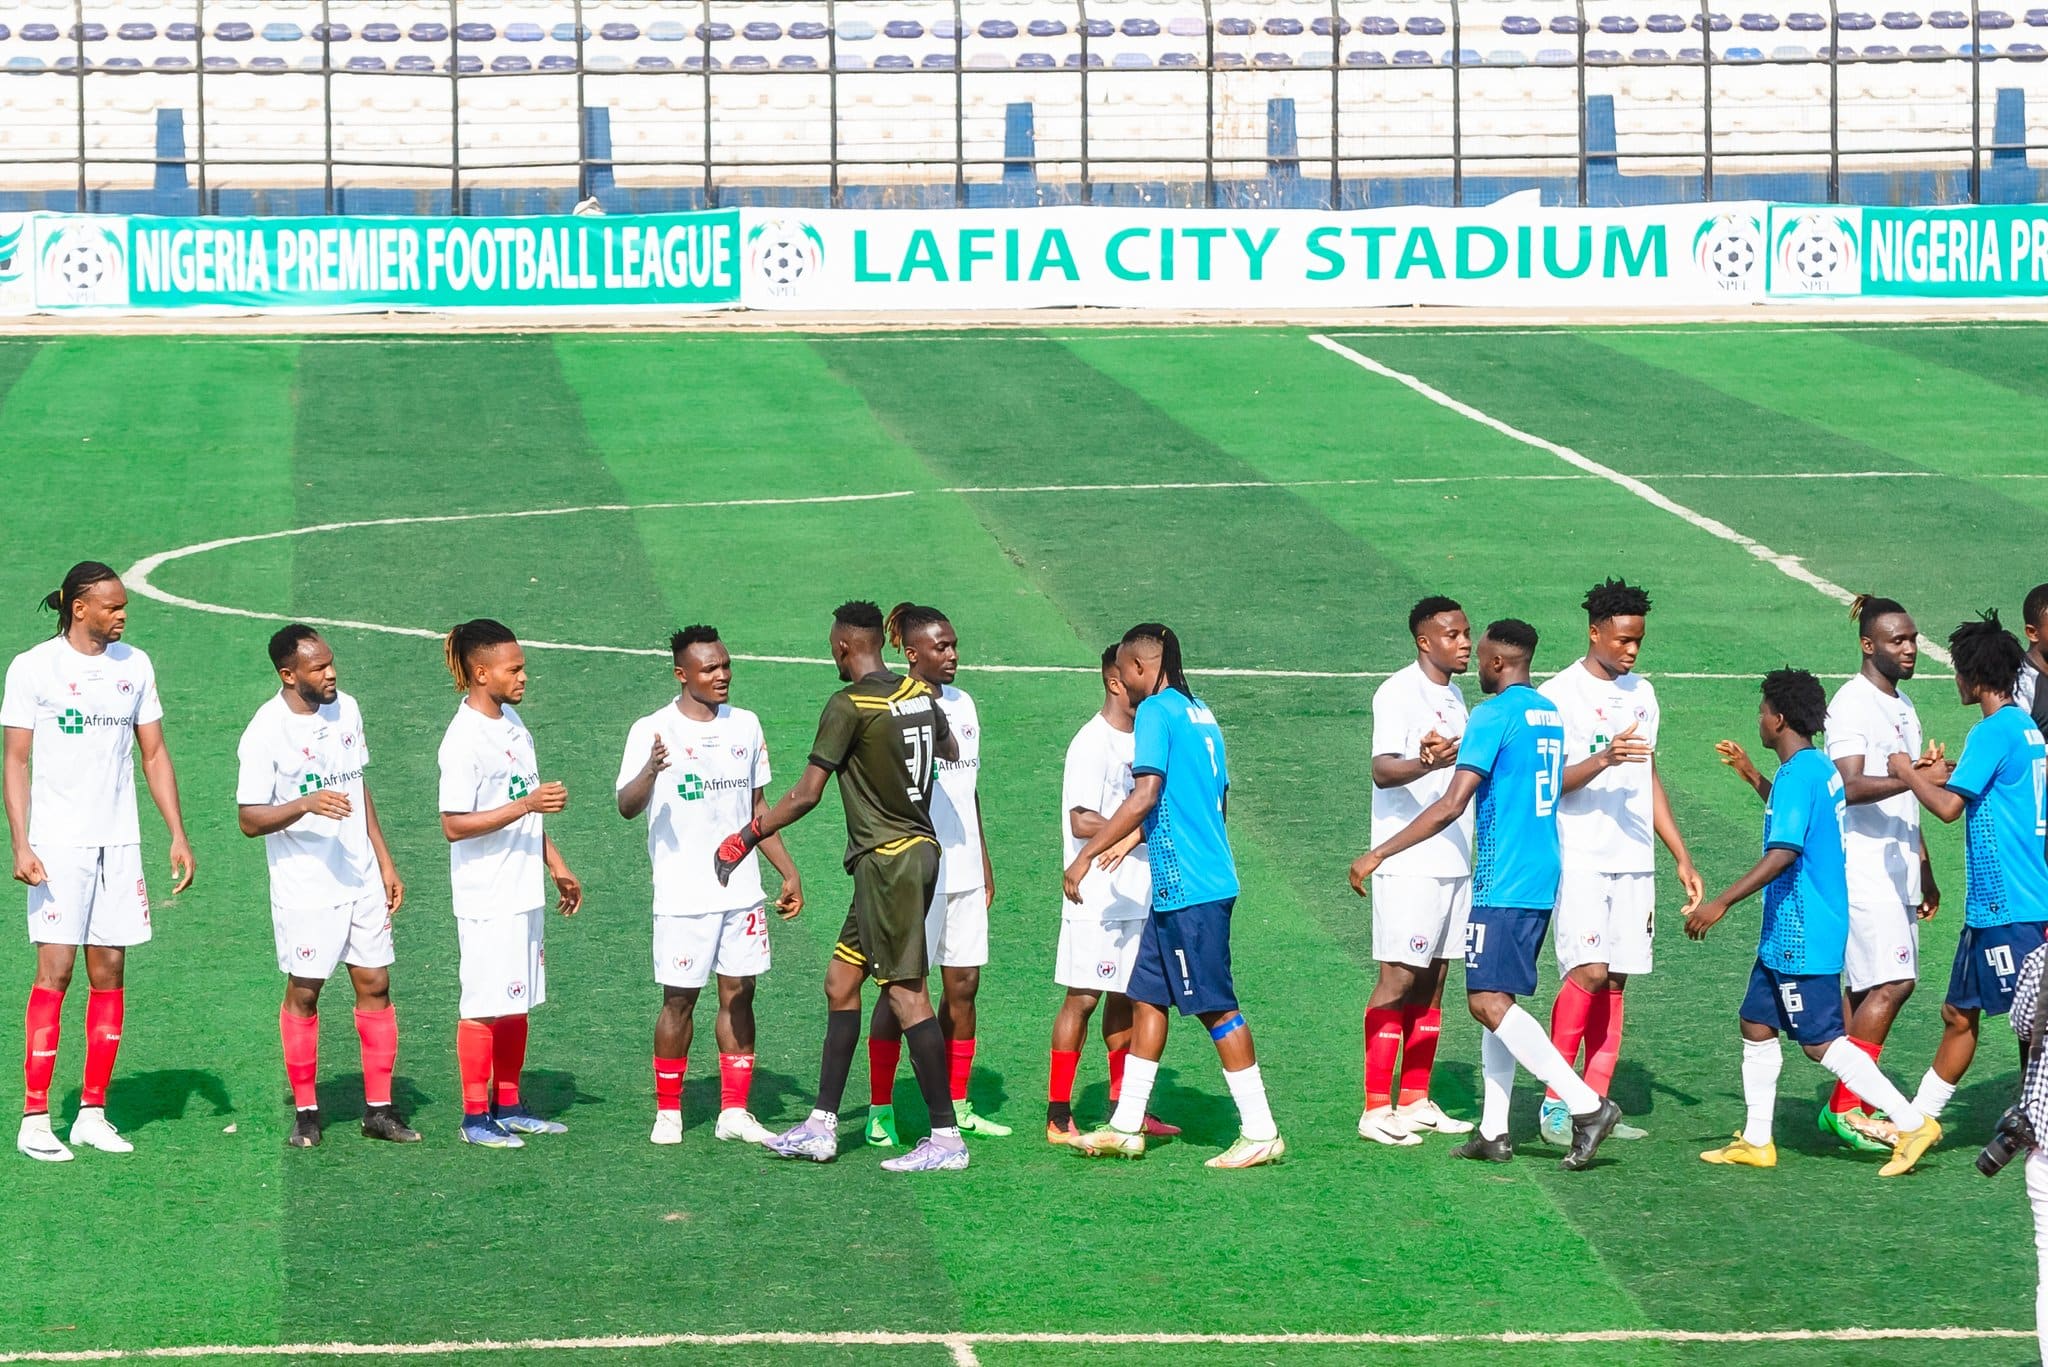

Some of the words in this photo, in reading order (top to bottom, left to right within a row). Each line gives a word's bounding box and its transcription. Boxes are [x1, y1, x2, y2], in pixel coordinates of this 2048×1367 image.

[135, 229, 271, 293] NIGERIA
[277, 228, 421, 293] PREMIER
[427, 227, 597, 291] FOOTBALL
[604, 225, 730, 288] LEAGUE
[854, 228, 1080, 283] LAFIA
[1105, 227, 1279, 282] CITY
[1306, 225, 1668, 281] STADIUM
[1870, 219, 2003, 283] NIGERIA
[1465, 922, 1486, 954] 21
[1984, 944, 2016, 977] 40
[1174, 949, 1189, 978] 1
